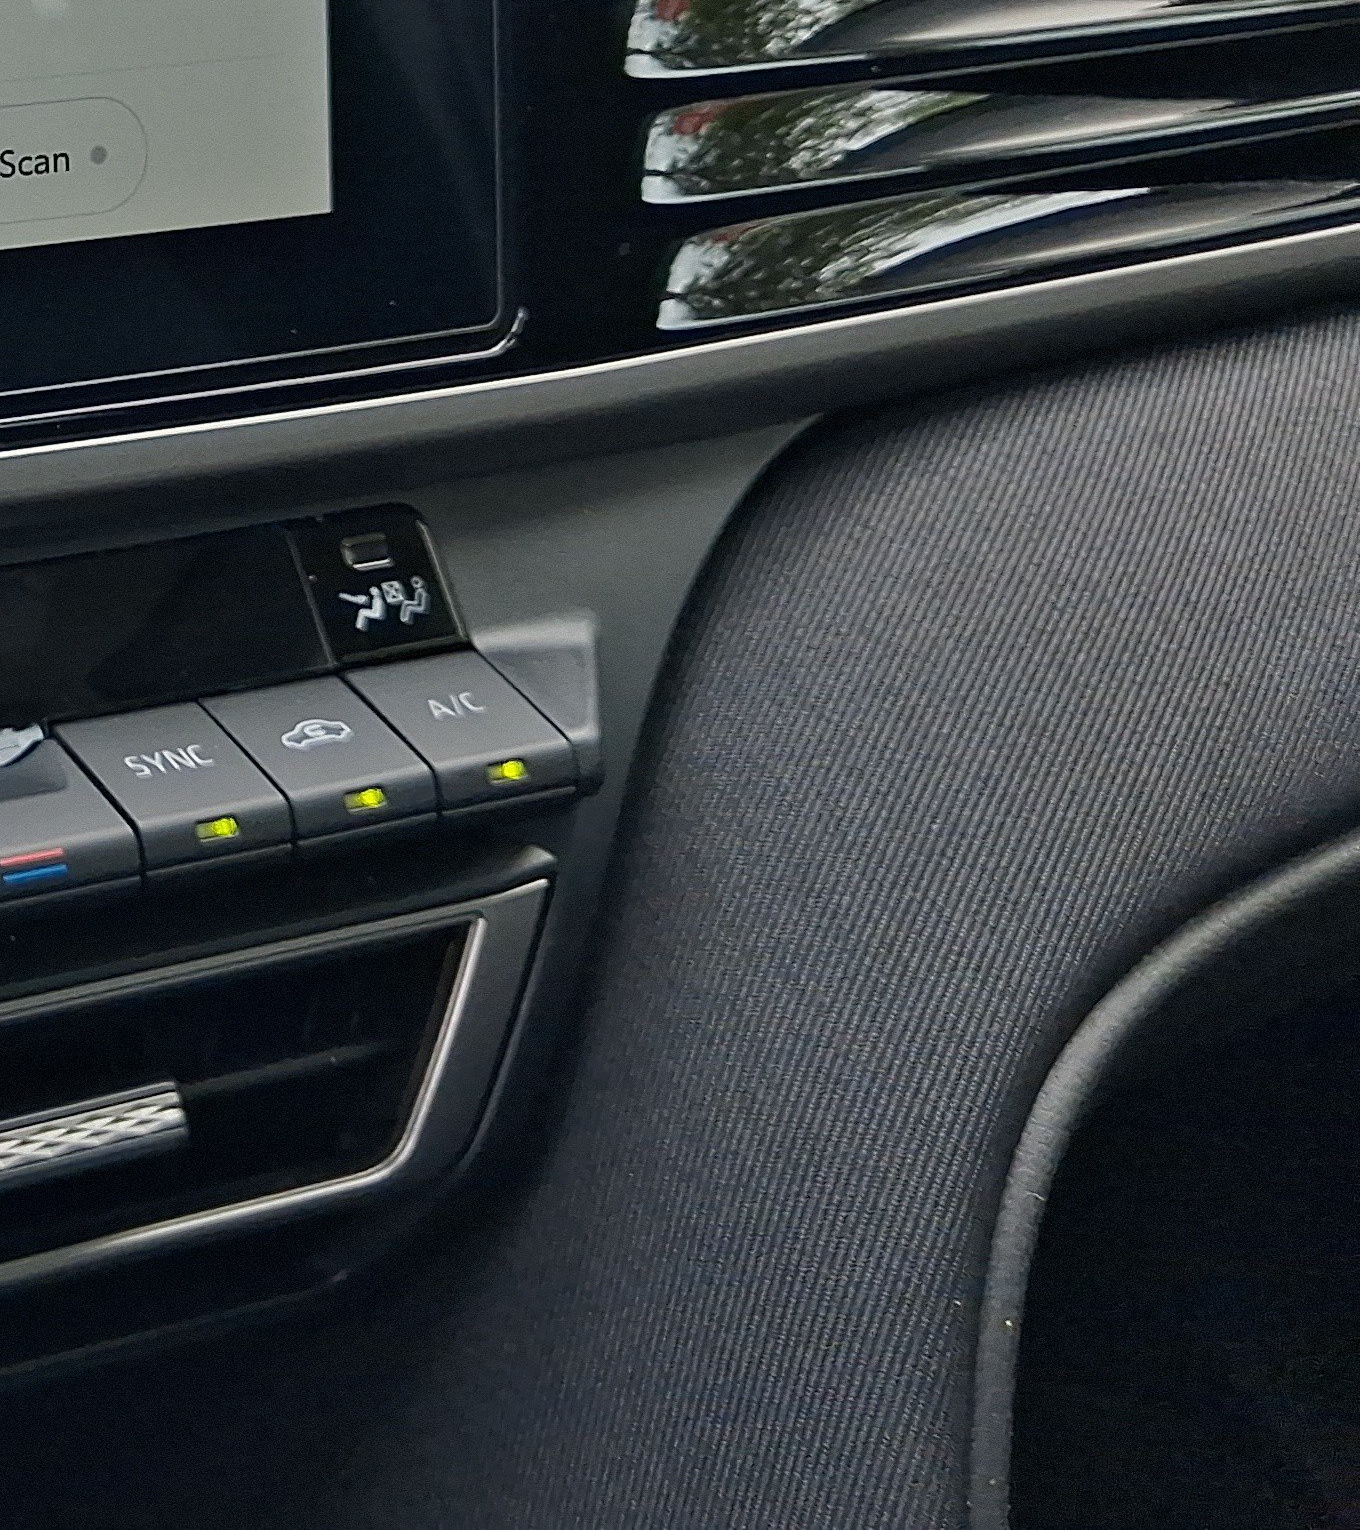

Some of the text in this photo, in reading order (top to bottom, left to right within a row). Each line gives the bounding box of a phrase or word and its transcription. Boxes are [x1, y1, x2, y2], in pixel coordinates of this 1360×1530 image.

[0, 149, 71, 179] Scan
[427, 691, 486, 721] A/C
[124, 744, 214, 779] SYNC
